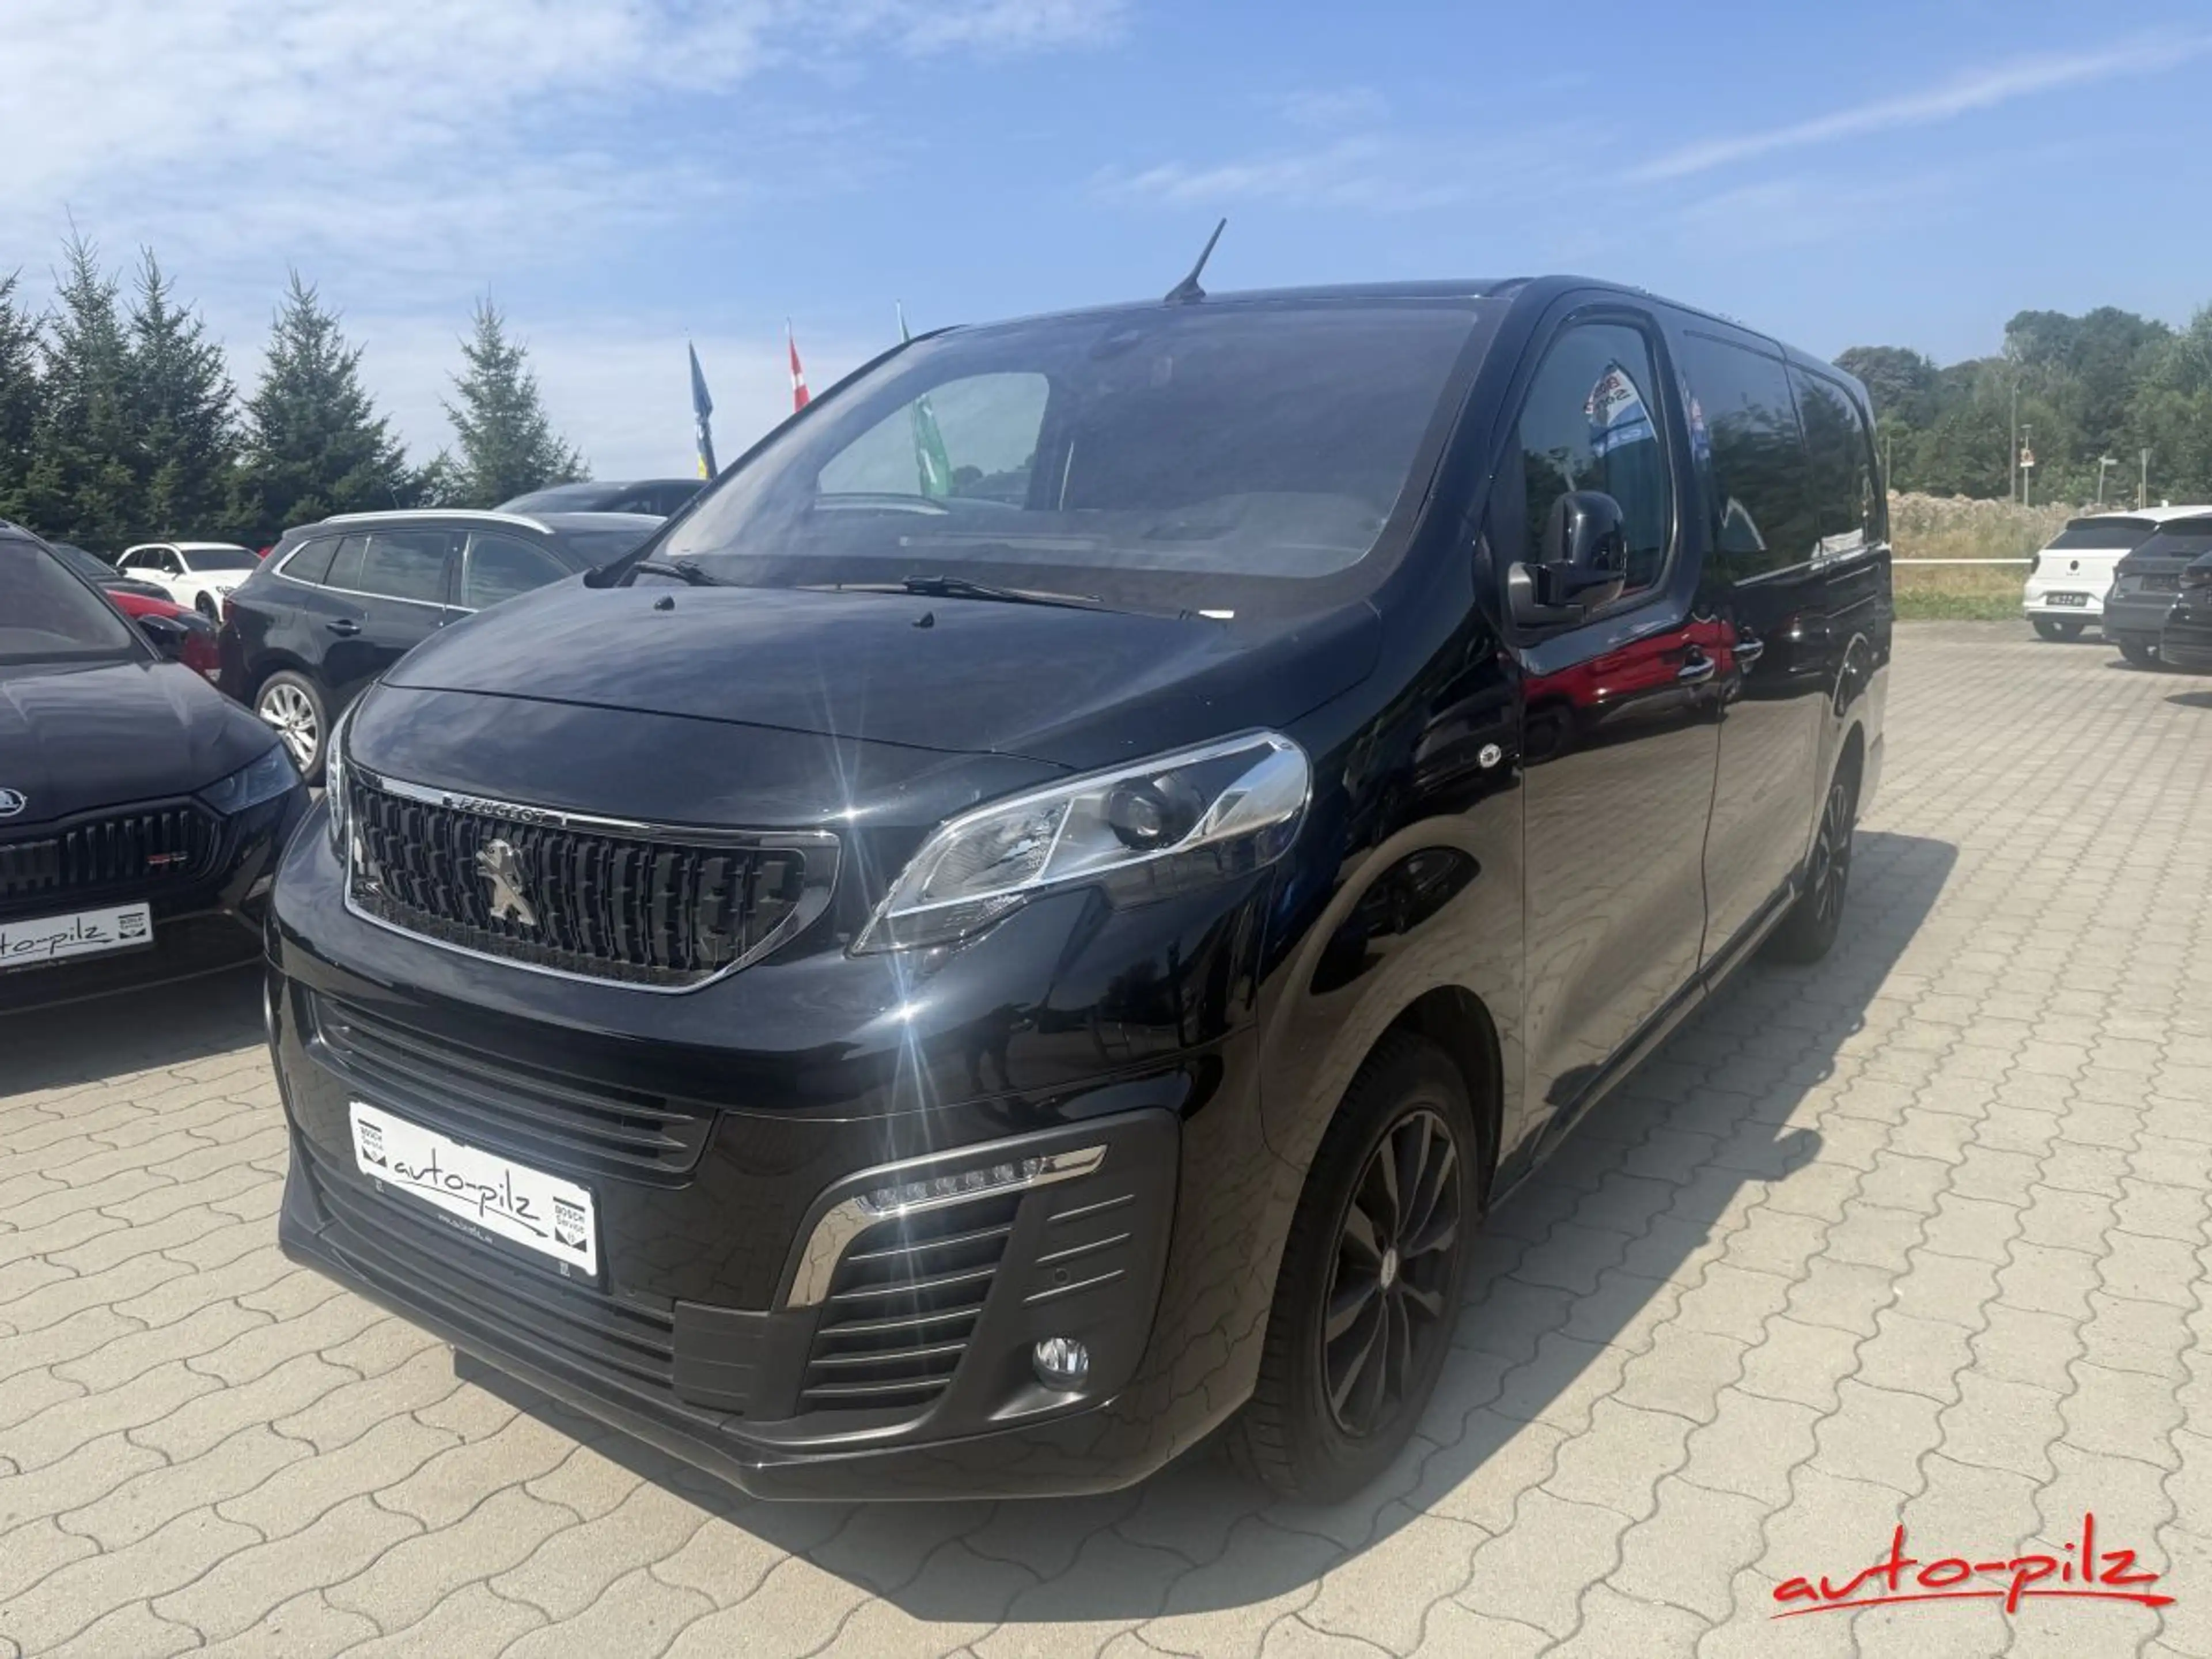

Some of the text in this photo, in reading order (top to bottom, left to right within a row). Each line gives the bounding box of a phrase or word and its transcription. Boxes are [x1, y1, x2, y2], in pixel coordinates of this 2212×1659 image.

[460, 797, 547, 824] PEUGEOT
[394, 1147, 540, 1218] auto-pilz
[555, 1205, 585, 1224] BOSCH
